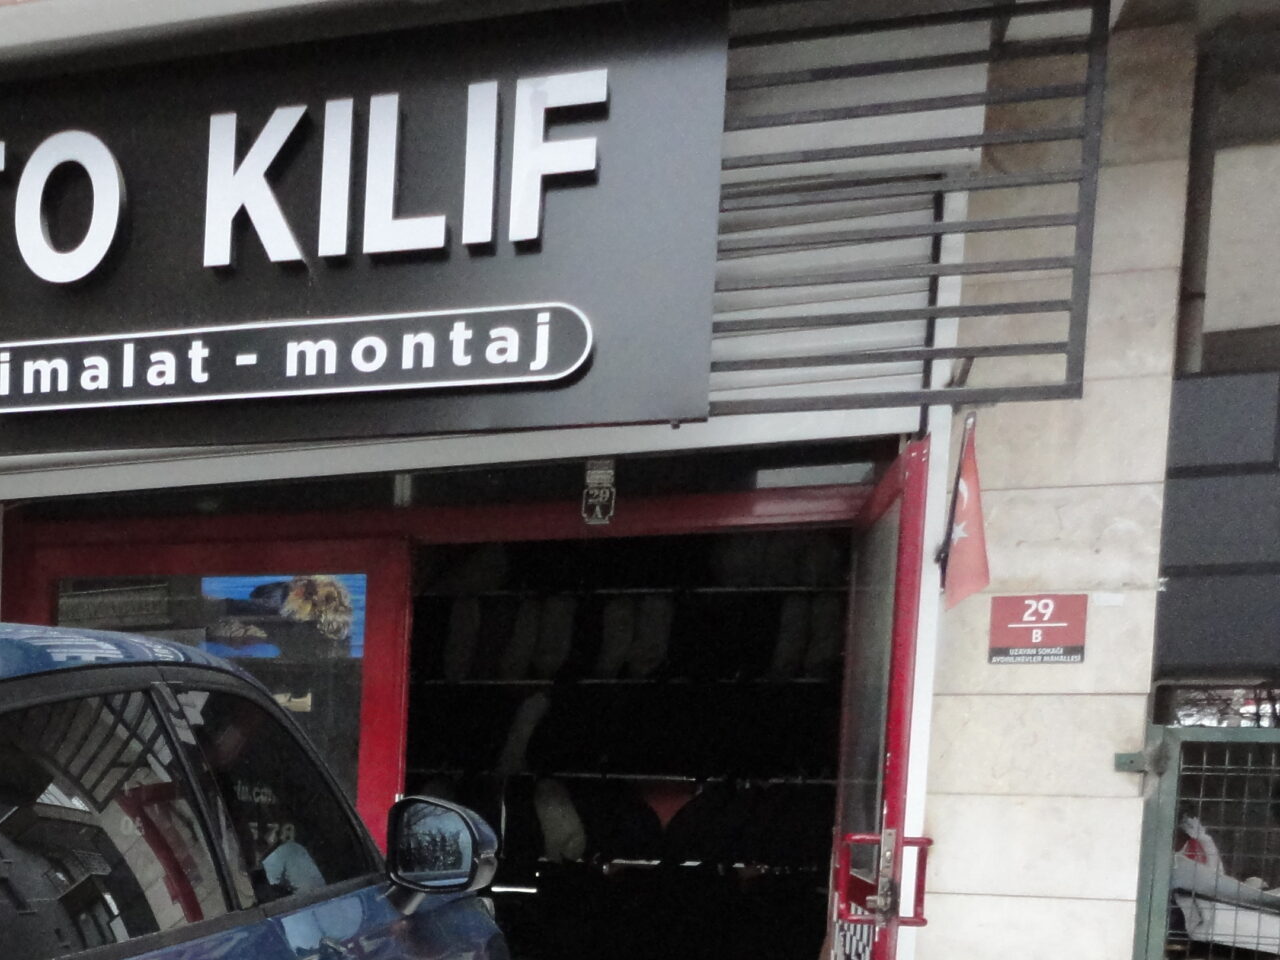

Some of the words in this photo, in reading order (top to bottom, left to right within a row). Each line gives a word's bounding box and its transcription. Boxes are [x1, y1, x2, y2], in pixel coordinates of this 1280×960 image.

[202, 68, 609, 268] KILIF
[285, 312, 551, 378] montaj
[1022, 598, 1055, 622] 29
[1031, 628, 1043, 643] B
